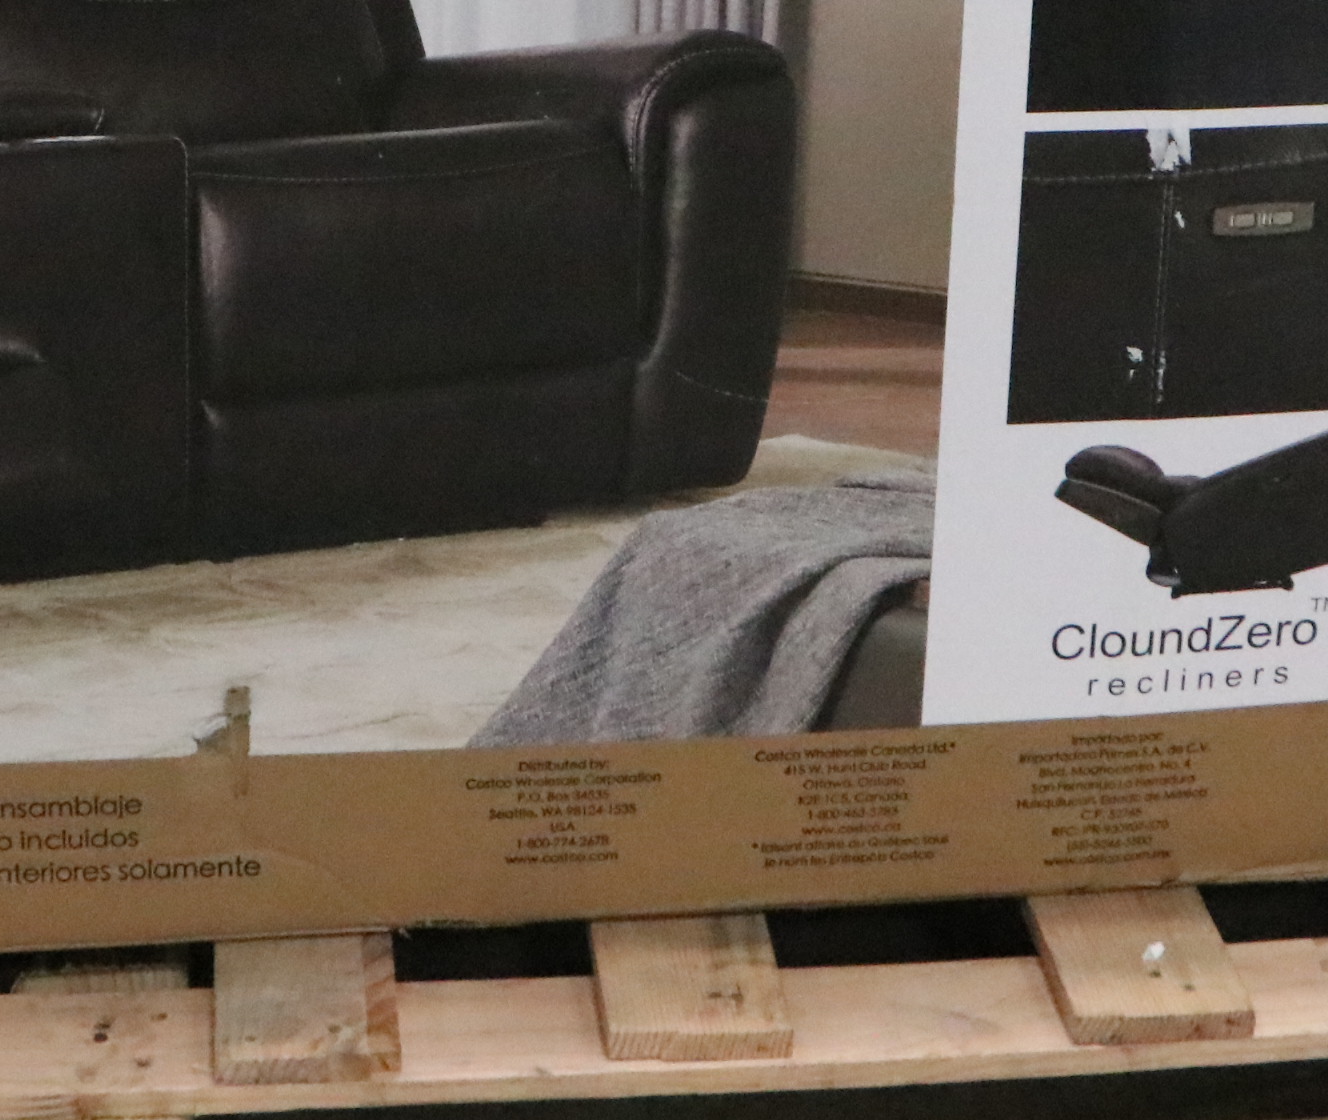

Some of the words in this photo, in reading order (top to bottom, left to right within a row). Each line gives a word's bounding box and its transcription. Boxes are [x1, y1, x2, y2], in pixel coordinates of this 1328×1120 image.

[1051, 615, 1318, 661] CloundZero
[1087, 665, 1291, 697] recliners
[119, 856, 261, 881] solamente
